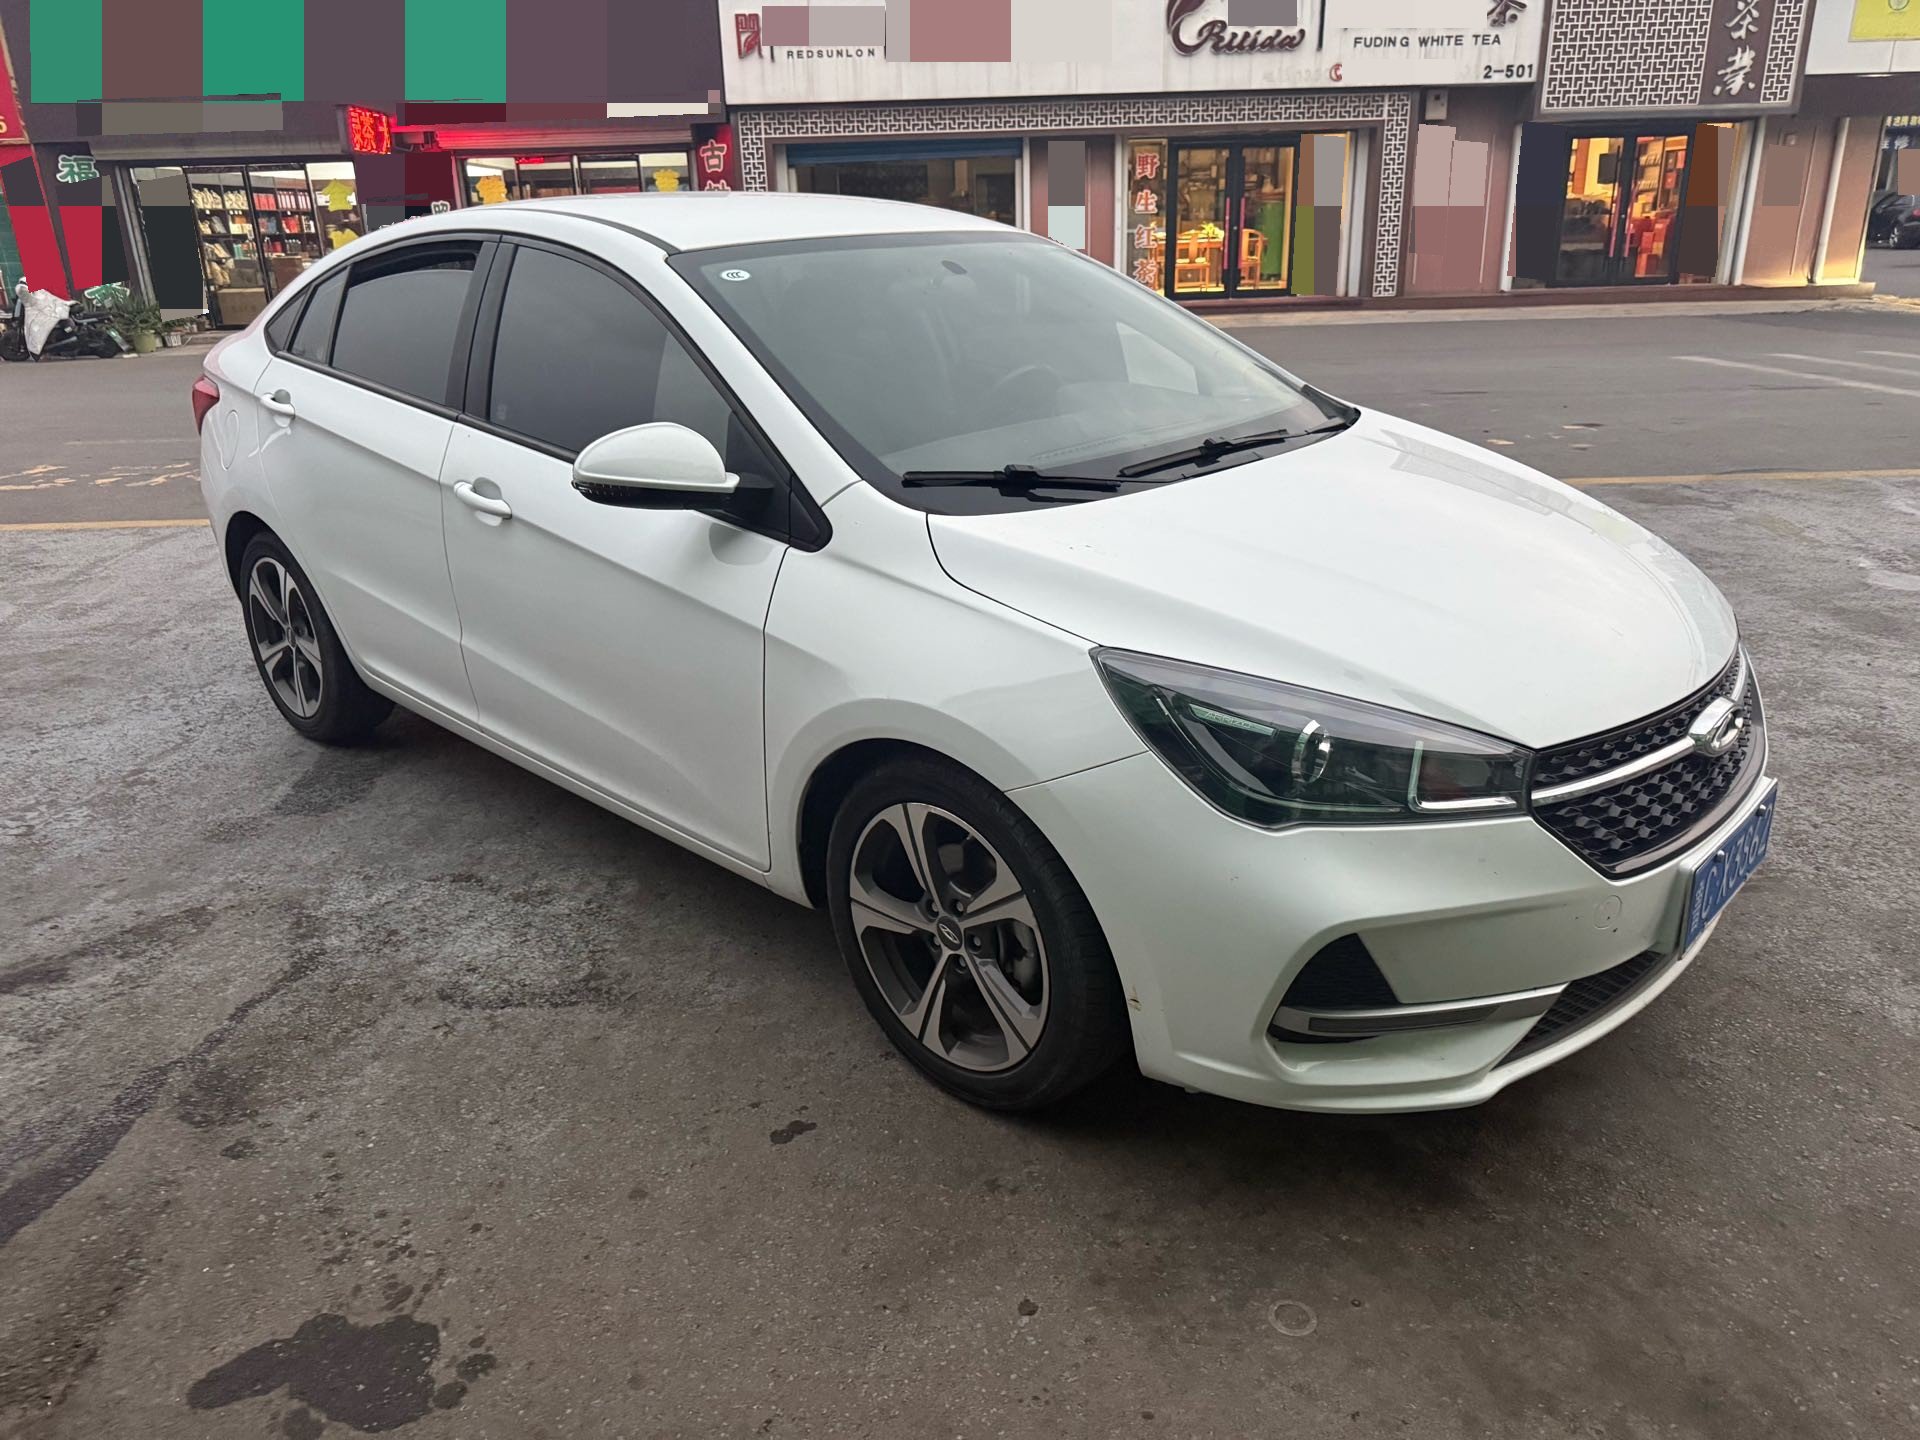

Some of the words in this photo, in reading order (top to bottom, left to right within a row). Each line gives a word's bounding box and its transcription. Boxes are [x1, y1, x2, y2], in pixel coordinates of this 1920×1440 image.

[1353, 36, 1410, 48] FUDING
[1418, 34, 1464, 46] WHITE
[1472, 34, 1501, 45] TEA
[786, 48, 876, 59] REDSUNLON
[1482, 63, 1535, 80] 2-501
[700, 139, 732, 192] 古
[1132, 152, 1160, 286] 野生红茶
